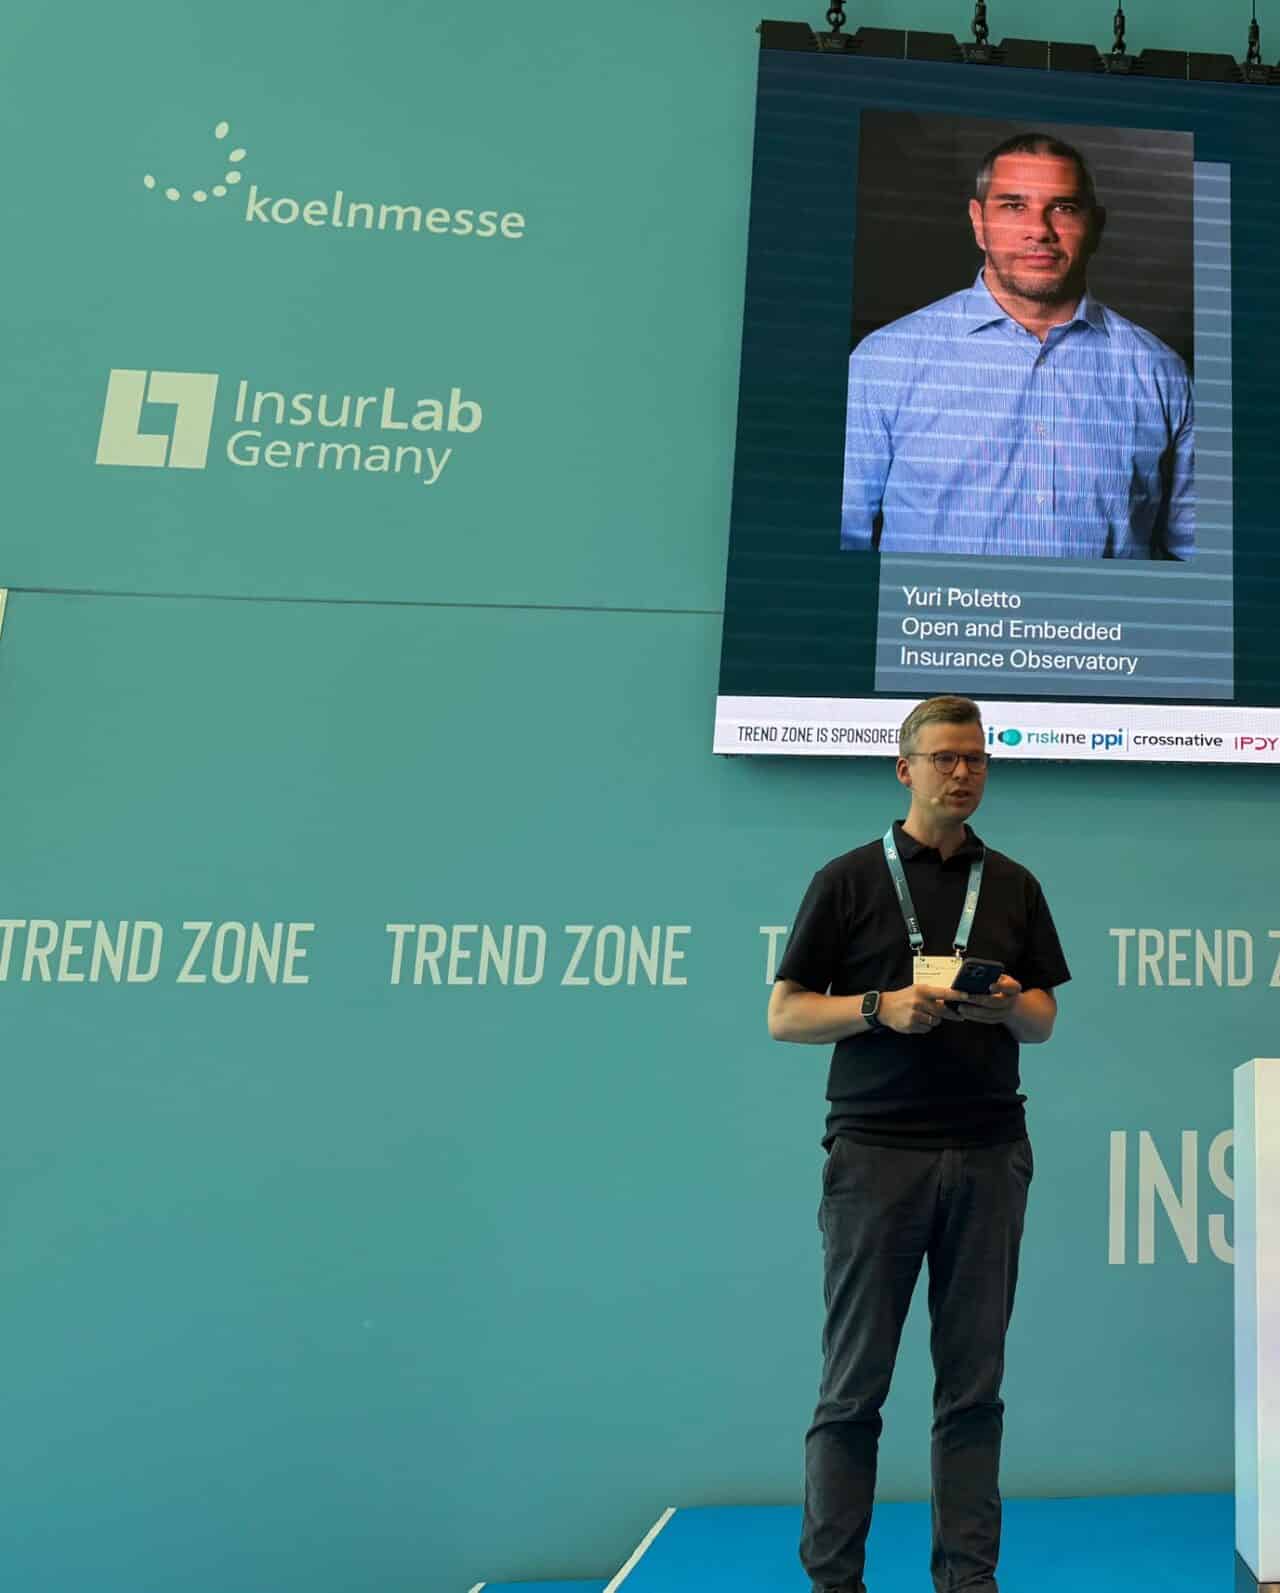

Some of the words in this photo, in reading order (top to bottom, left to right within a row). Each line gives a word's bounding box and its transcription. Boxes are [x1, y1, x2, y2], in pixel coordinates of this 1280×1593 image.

[246, 185, 526, 239] koelnmesse
[234, 380, 483, 433] InsurLab
[226, 430, 453, 485] Germany
[901, 586, 941, 606] Yuri
[947, 588, 1021, 609] Poletto
[901, 617, 958, 639] Open
[965, 620, 1003, 638] and
[1009, 620, 1122, 641] Embedded
[900, 646, 1004, 667] Insurance
[1010, 649, 1138, 674] Observatory
[738, 726, 777, 742] TREND
[781, 727, 813, 743] ZONE
[816, 728, 828, 743] IS
[1091, 728, 1122, 750] ppi
[1132, 733, 1223, 748] crossnative
[0, 920, 164, 983] TREND
[176, 921, 315, 984] ZONE
[386, 924, 547, 985] TREND
[560, 924, 692, 986] ZONE
[1109, 928, 1253, 987] TREND
